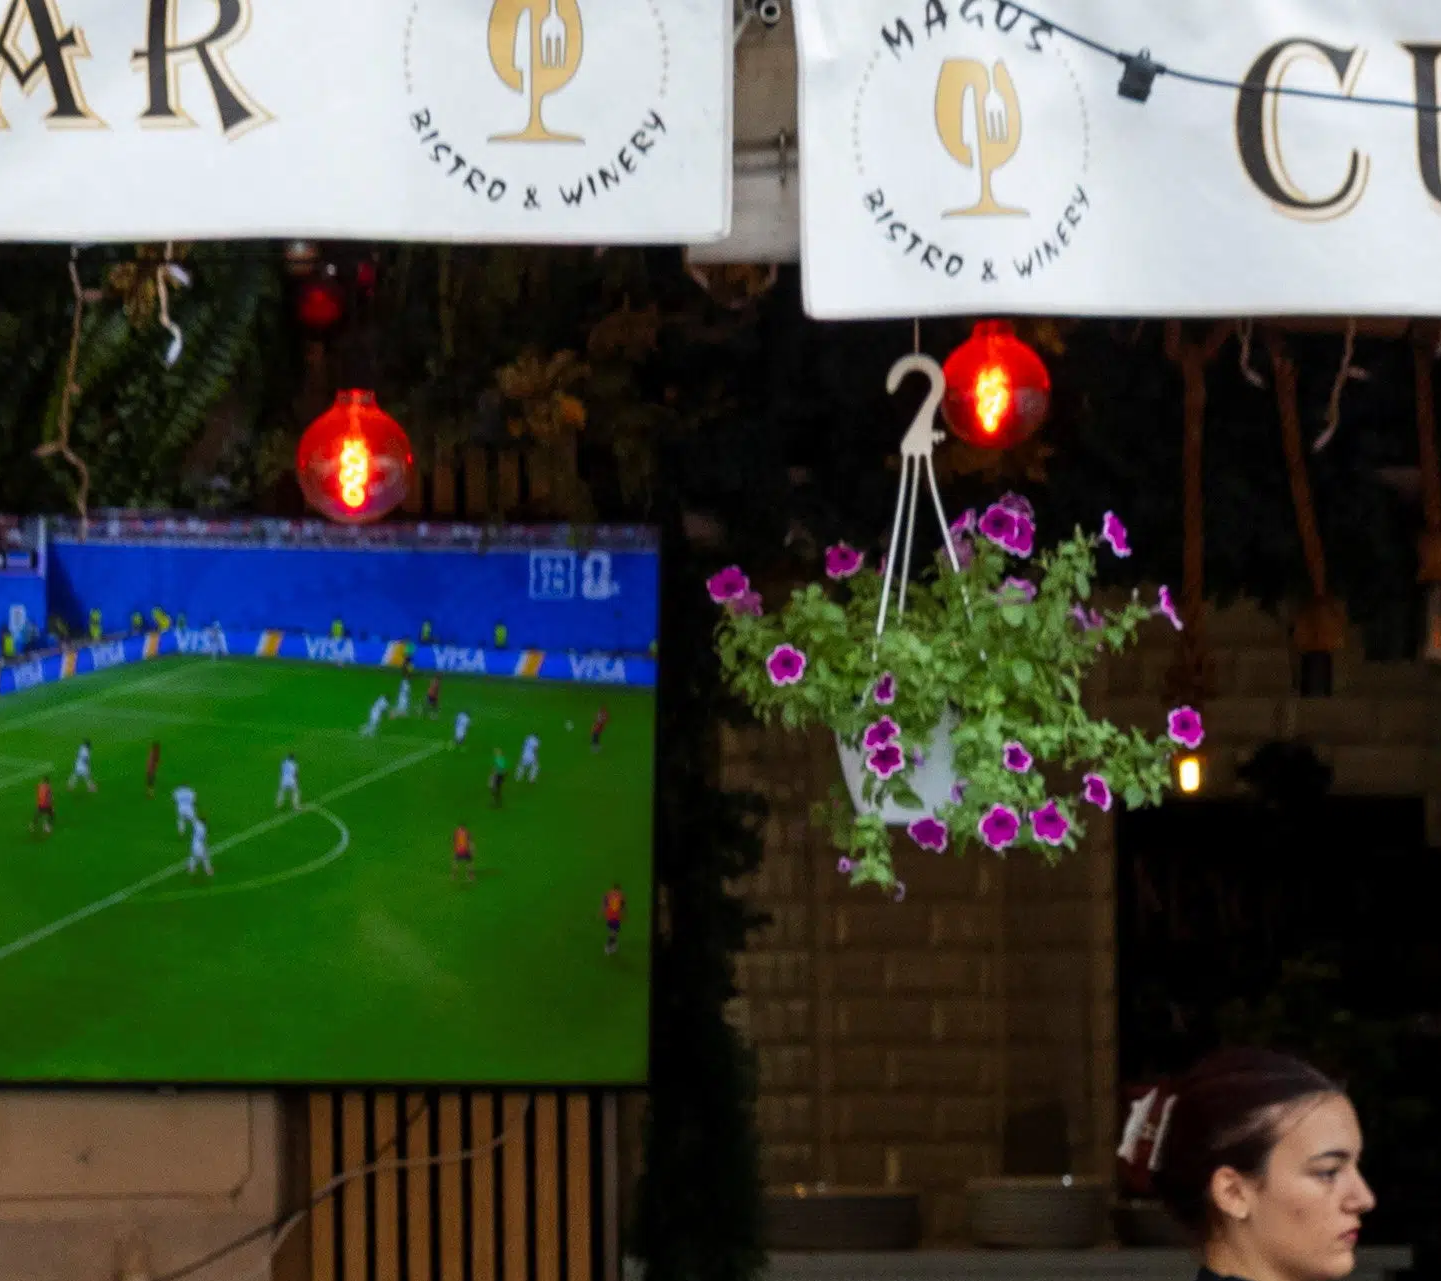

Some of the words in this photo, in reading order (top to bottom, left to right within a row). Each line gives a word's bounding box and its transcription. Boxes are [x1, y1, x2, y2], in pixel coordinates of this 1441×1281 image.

[880, 0, 1053, 61] MAGUS
[409, 107, 507, 202] BISTRO
[523, 183, 542, 210] &
[558, 107, 667, 208] WINERY
[862, 186, 964, 277] BISTRO
[980, 257, 998, 282] &
[1013, 183, 1091, 279] WINERY
[433, 646, 485, 673] VISA
[569, 653, 626, 683] VISA
